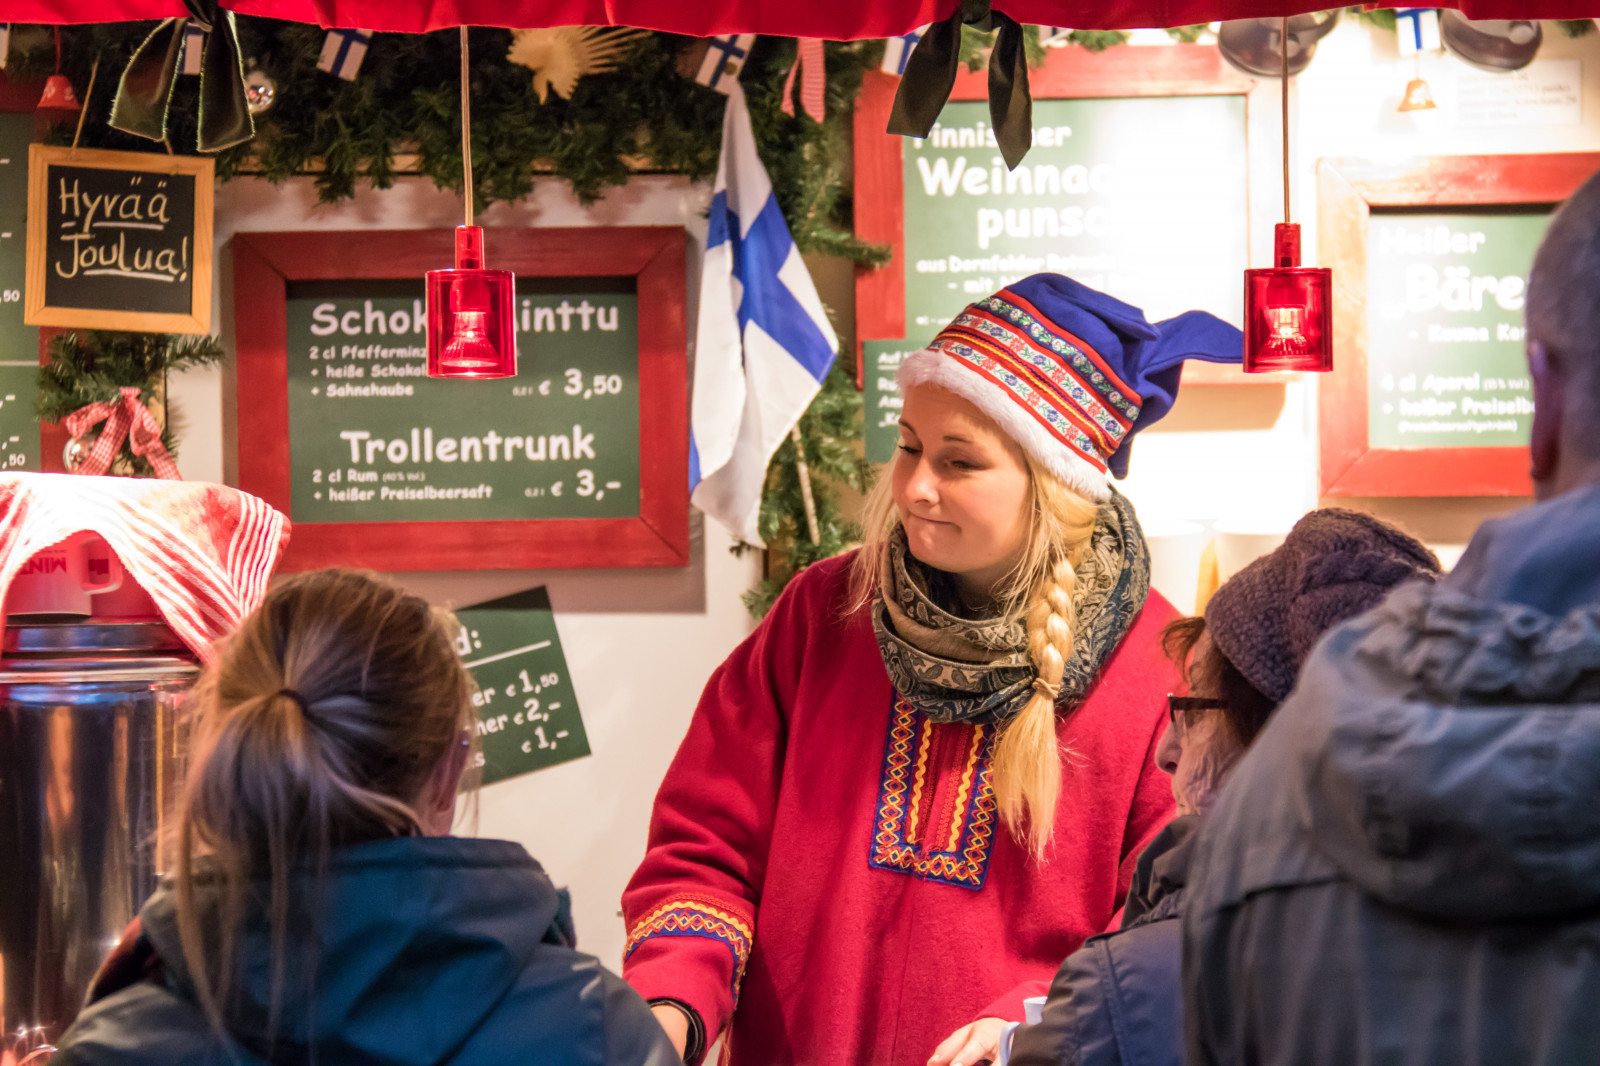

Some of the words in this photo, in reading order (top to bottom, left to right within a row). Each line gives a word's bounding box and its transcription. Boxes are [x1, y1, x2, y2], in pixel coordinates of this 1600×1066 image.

[59, 176, 170, 234] Hyvää
[55, 231, 188, 282] Joulua!
[516, 300, 619, 332] inttu
[309, 346, 319, 359] 2
[322, 345, 336, 359] cl
[326, 364, 364, 378] heiße
[564, 367, 622, 400] 3,50
[326, 382, 414, 397] Sahnehaube
[340, 424, 596, 464] Trollentrunk
[313, 469, 322, 483] 2
[328, 468, 341, 483] cl
[347, 468, 378, 482] Rum
[576, 468, 622, 501] 3,-
[329, 486, 375, 501] heißer
[381, 484, 493, 500] Preiselbeersaft
[518, 669, 559, 694] 1,50
